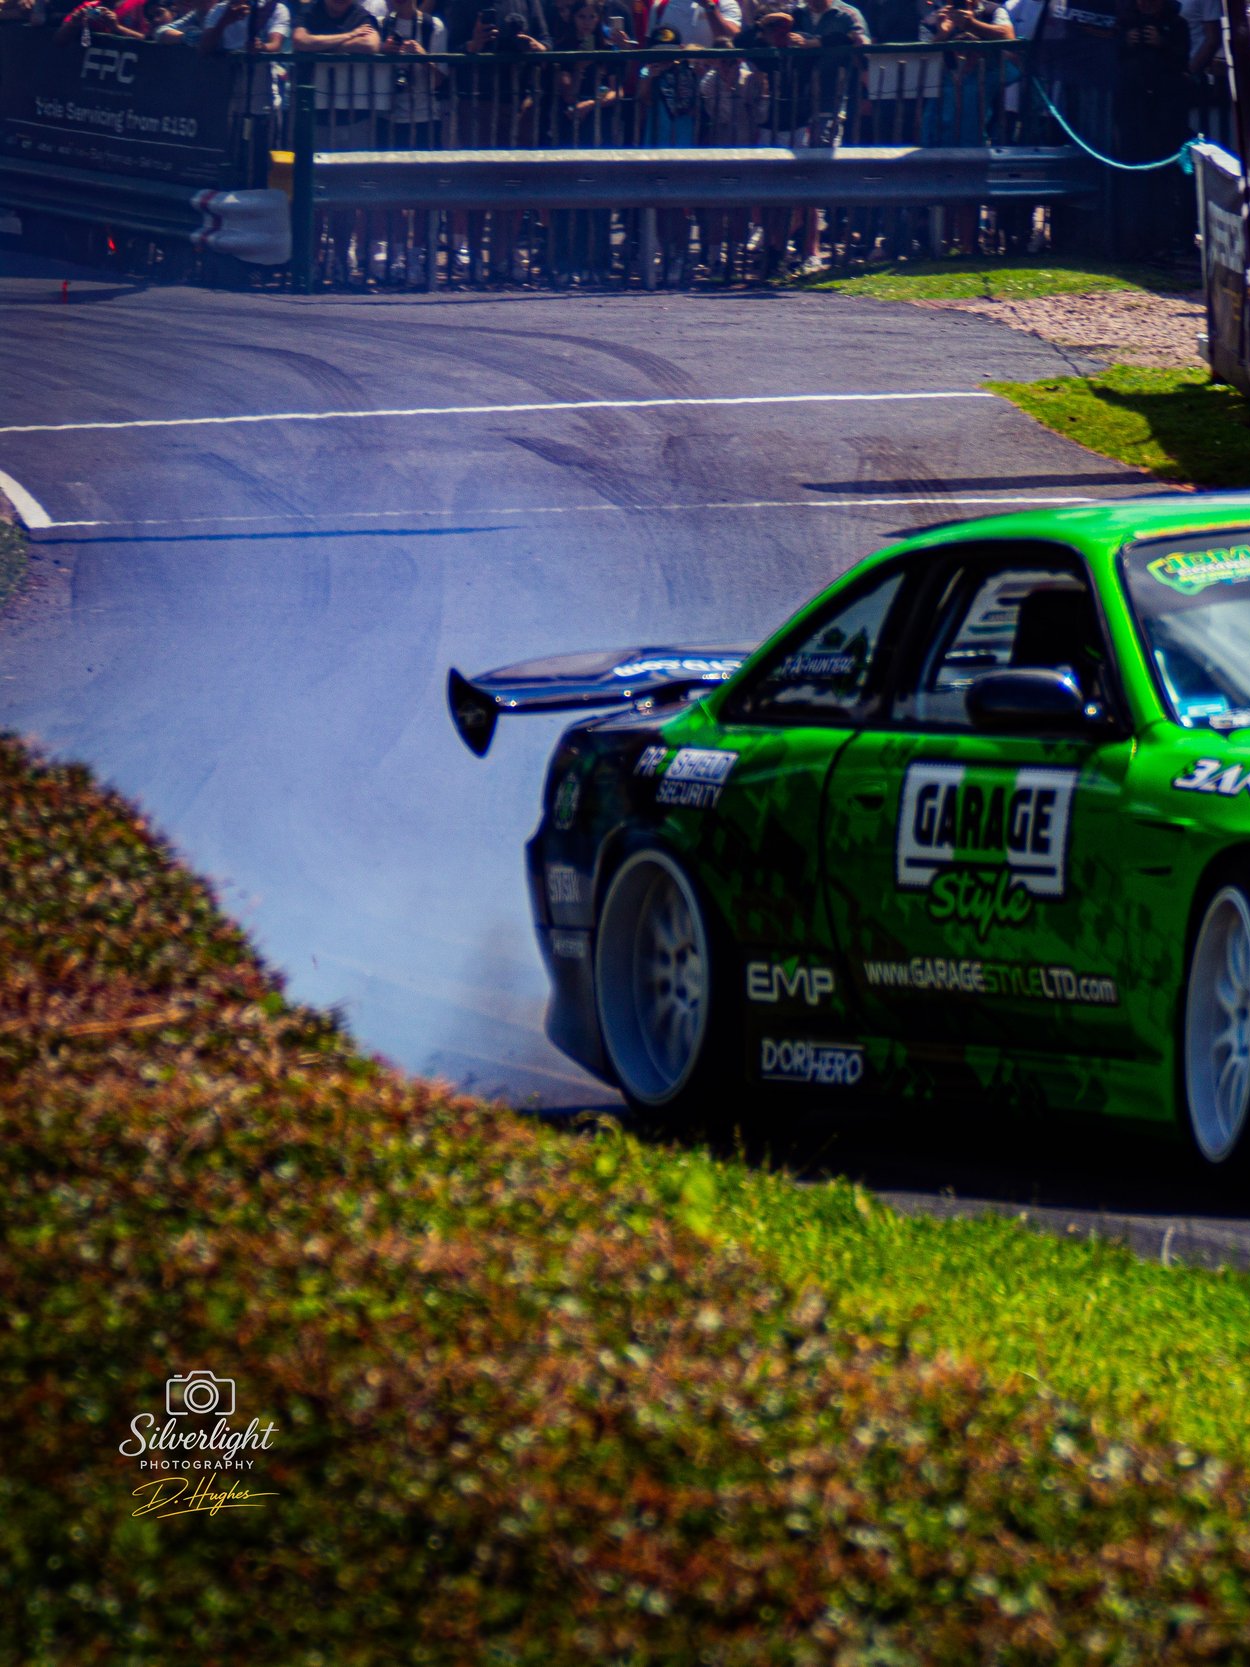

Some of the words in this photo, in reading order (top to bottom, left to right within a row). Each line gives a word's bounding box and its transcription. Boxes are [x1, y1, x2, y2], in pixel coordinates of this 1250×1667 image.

[80, 48, 138, 84] FPC
[126, 109, 161, 130] from
[656, 779, 722, 809] SECURITY
[914, 784, 1058, 854] GARAGE
[929, 870, 1031, 938] Style
[747, 960, 835, 1006] EMP
[863, 957, 1117, 1004] www.GARAGESTYLELTD.com
